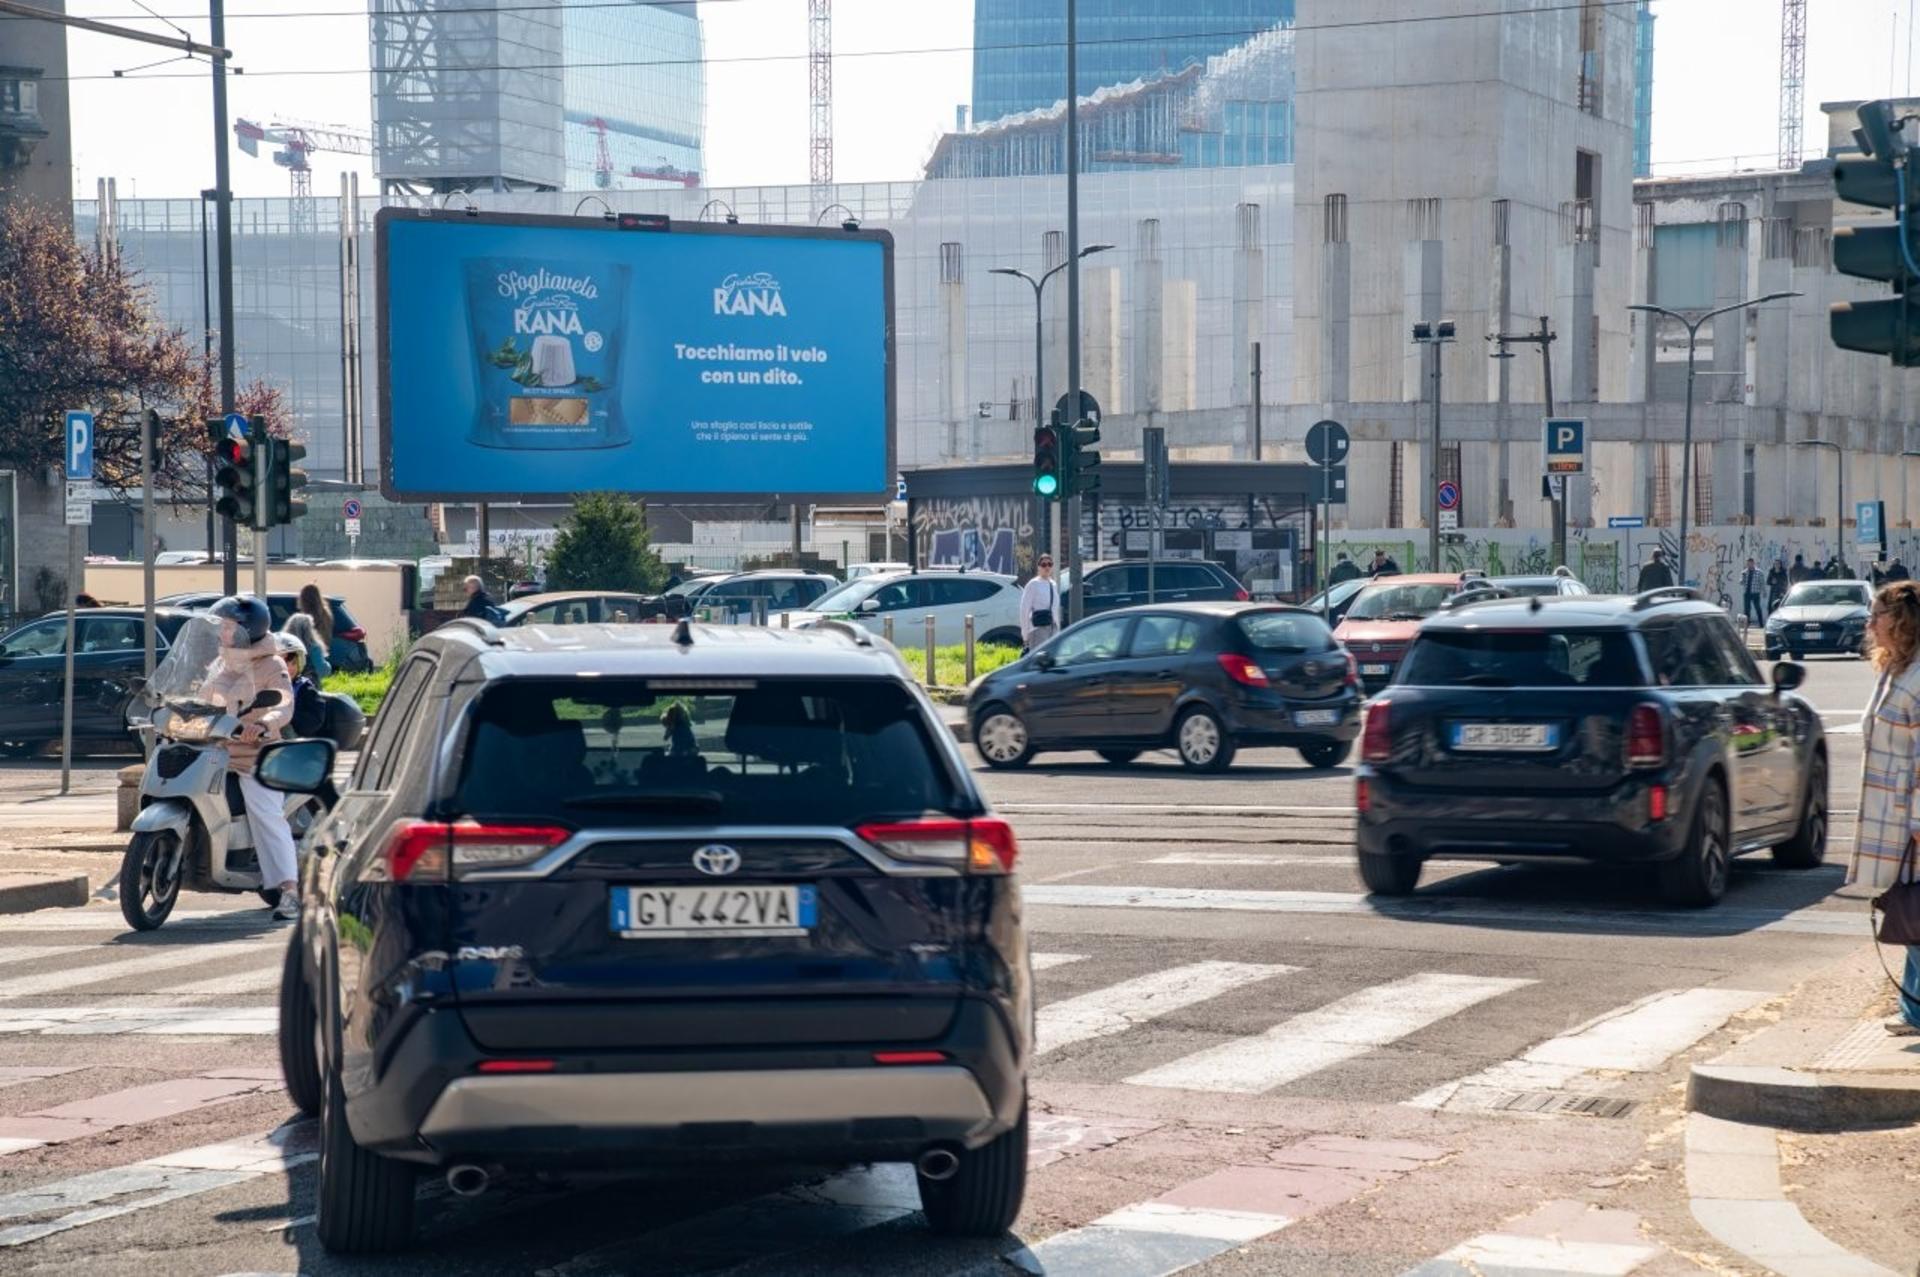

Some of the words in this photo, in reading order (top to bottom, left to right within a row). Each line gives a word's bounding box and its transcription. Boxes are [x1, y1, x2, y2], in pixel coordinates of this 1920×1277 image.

[497, 267, 599, 300] Sfogliavelo
[713, 287, 787, 316] RANA
[513, 308, 585, 335] RANA
[674, 343, 775, 361] Tocchiamo
[777, 344, 788, 362] il
[790, 346, 828, 363] velo
[701, 370, 735, 383] con
[737, 371, 761, 384] un
[763, 367, 803, 385] dito.
[71, 419, 88, 471] P
[1557, 427, 1575, 450] P
[1861, 506, 1873, 525] P
[637, 892, 676, 926] GY
[690, 890, 792, 925] 442VA
